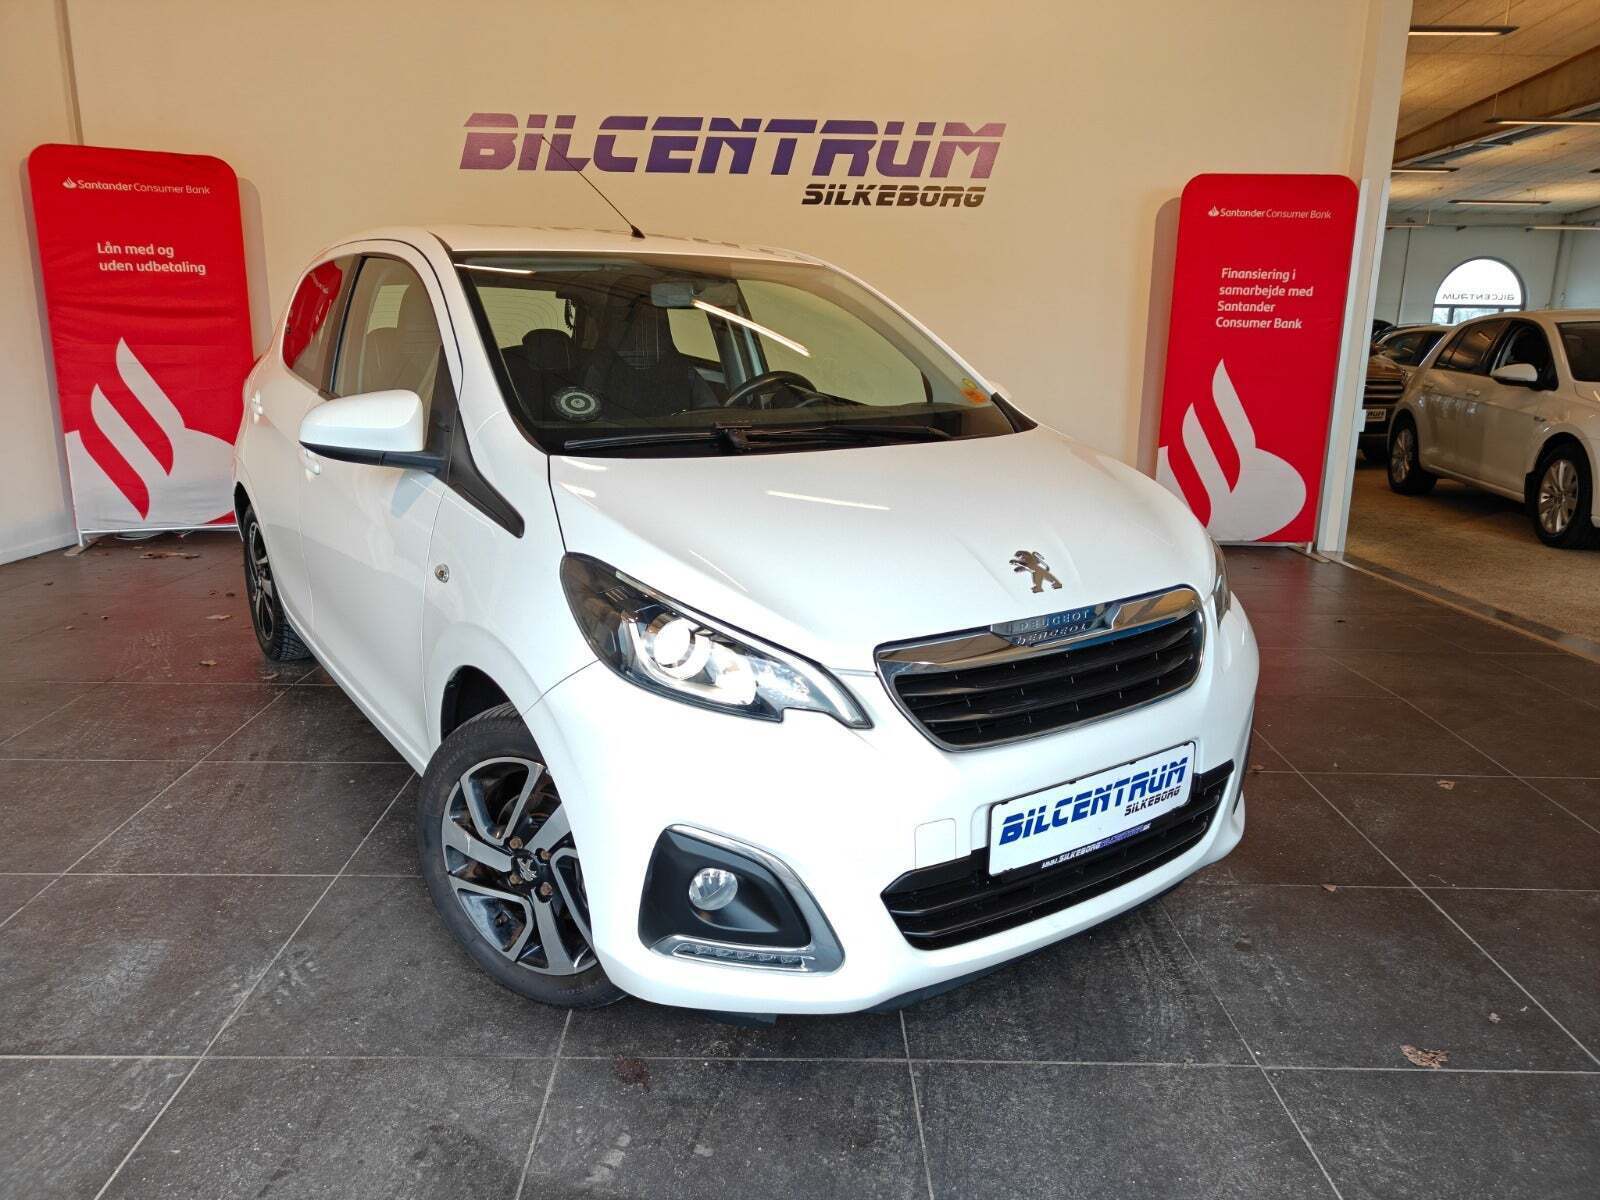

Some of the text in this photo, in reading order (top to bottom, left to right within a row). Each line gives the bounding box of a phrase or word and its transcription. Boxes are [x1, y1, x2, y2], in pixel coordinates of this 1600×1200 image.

[460, 113, 1006, 179] BILCENTRUM
[77, 179, 210, 194] Santander Consumer Bank
[802, 184, 986, 208] SILKEBORG
[1220, 208, 1331, 219] Santander Consumer Bank
[97, 241, 174, 258] Lån med og
[98, 260, 206, 275] uden udbetaling
[1221, 267, 1297, 283] Finansiering i
[1219, 284, 1314, 299] samarbejde med
[1217, 300, 1276, 312] Santander
[1216, 316, 1302, 329] Consumer Bank
[1021, 609, 1090, 632] PEUGEOT
[999, 757, 1188, 846] BILCENTRUM
[1124, 786, 1181, 817] SILKEBORG
